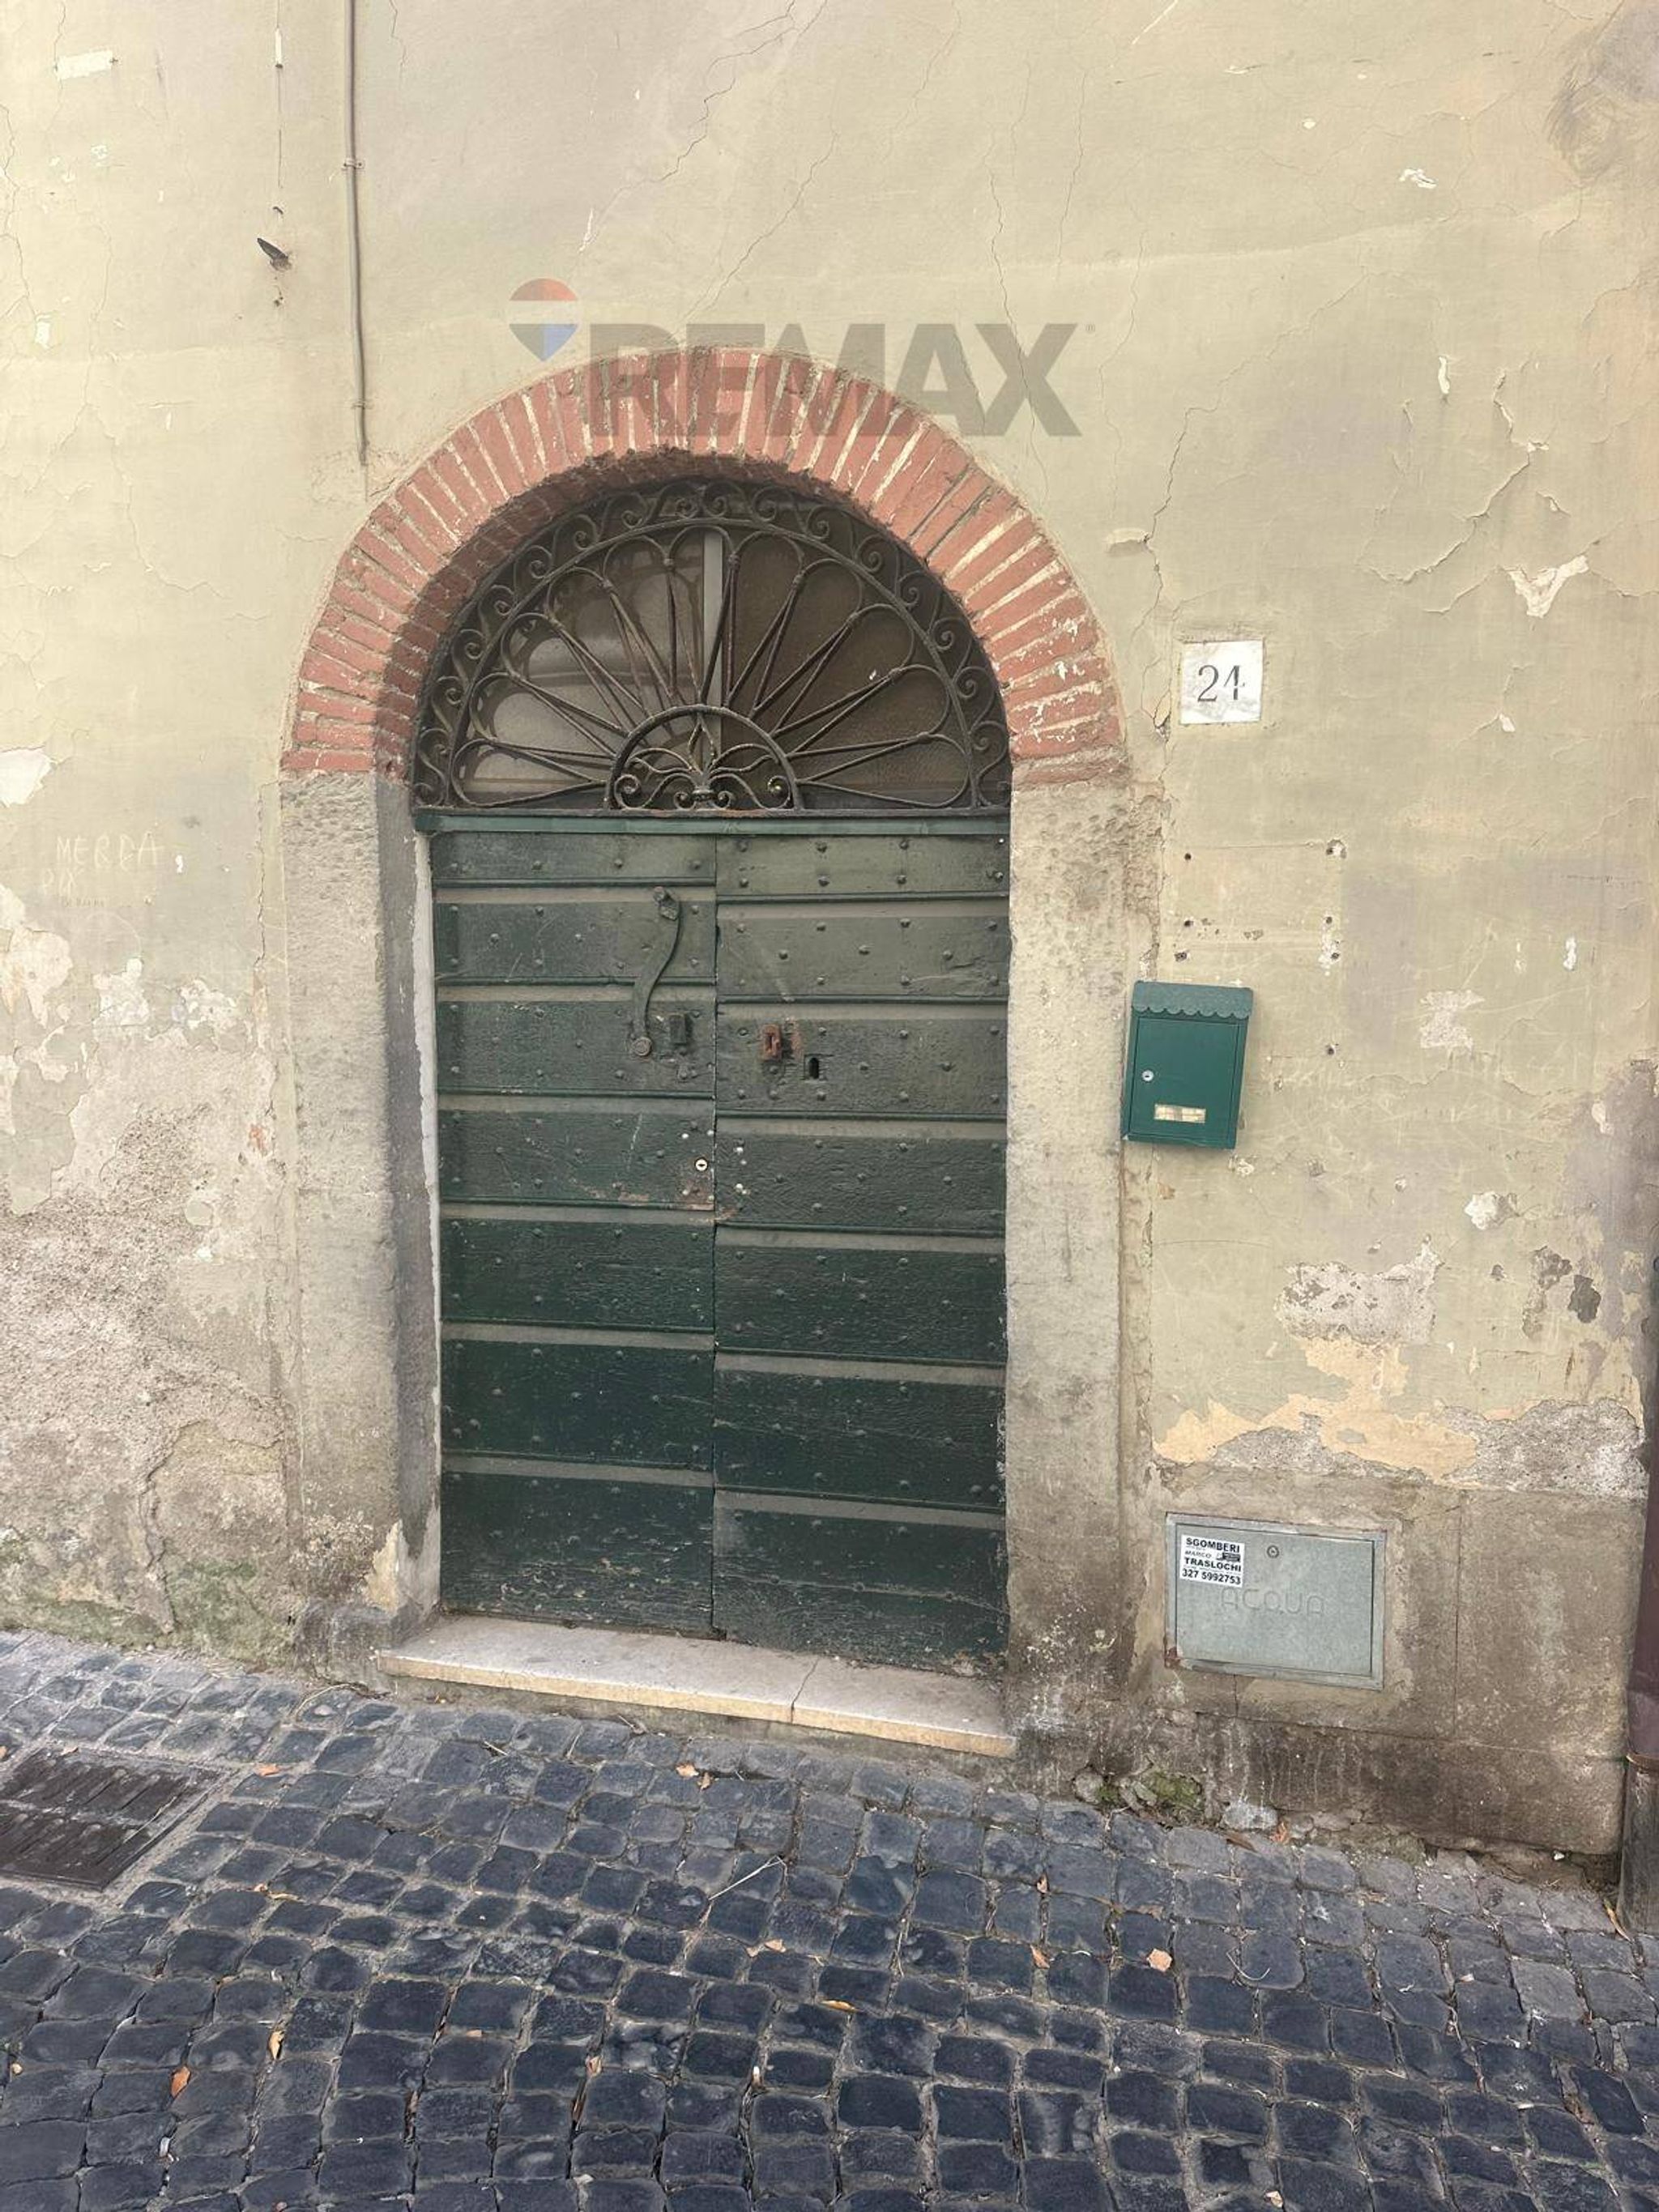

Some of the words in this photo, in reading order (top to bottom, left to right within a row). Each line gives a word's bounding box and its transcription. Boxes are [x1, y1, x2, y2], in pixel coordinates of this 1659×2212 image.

[1198, 665, 1245, 702] 24
[1186, 1537, 1240, 1553] SGOMBERI
[1185, 1557, 1241, 1572] TRASLOCHI
[1182, 1568, 1199, 1578] 327
[1201, 1571, 1241, 1585] 5992753
[1221, 1587, 1324, 1616] ACQUA
